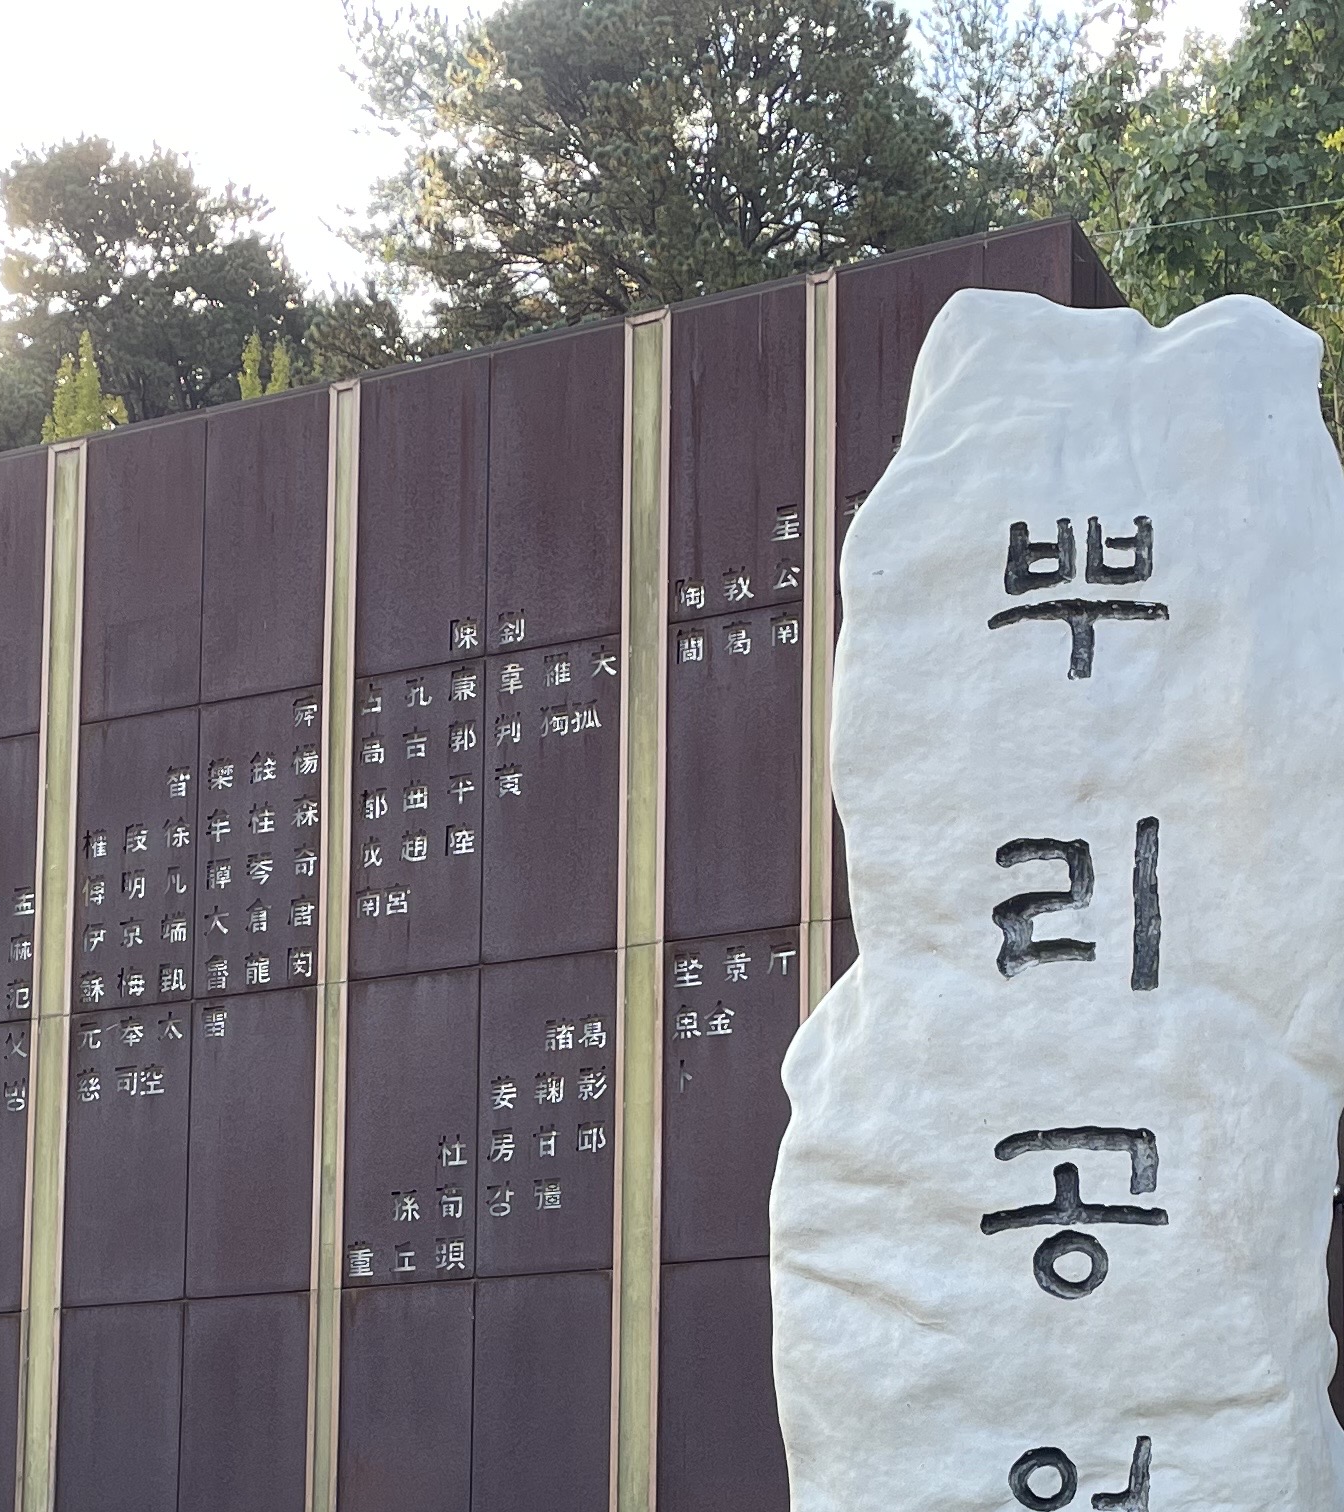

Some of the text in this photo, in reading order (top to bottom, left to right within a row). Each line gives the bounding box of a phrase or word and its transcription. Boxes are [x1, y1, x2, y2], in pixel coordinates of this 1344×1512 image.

[771, 504, 800, 541] 星
[675, 558, 800, 612] 陶 敦 公
[450, 608, 525, 651] 陳 劉
[677, 612, 799, 665] 簡 葛 南
[405, 676, 432, 708] 孔
[544, 652, 571, 687] 羅
[360, 731, 385, 765] 高
[403, 726, 430, 759] 吉
[448, 719, 477, 753] 郭
[165, 765, 191, 798] 智
[249, 751, 277, 784] 錢
[292, 743, 319, 776] 楊
[403, 779, 428, 813] 曲
[447, 772, 475, 804] 平
[162, 816, 190, 848] 徐
[248, 801, 275, 834] 桂
[291, 793, 319, 828] 森
[399, 828, 427, 862] 趙
[121, 868, 146, 900] 明
[246, 851, 273, 885] 琴
[293, 843, 318, 877] 奇
[119, 916, 143, 948] 京
[160, 910, 187, 943] 端
[204, 905, 230, 936] 大
[117, 966, 145, 997] 梅
[244, 951, 271, 985] 龍
[722, 946, 751, 982] 景
[78, 1022, 102, 1050] 元
[158, 1011, 183, 1041] 太
[490, 1075, 517, 1110] 姜
[438, 1133, 468, 1167] 杜
[486, 1128, 515, 1163] 房
[532, 1123, 561, 1158] 甘
[391, 1189, 420, 1222] 孫
[486, 1180, 515, 1217] 강
